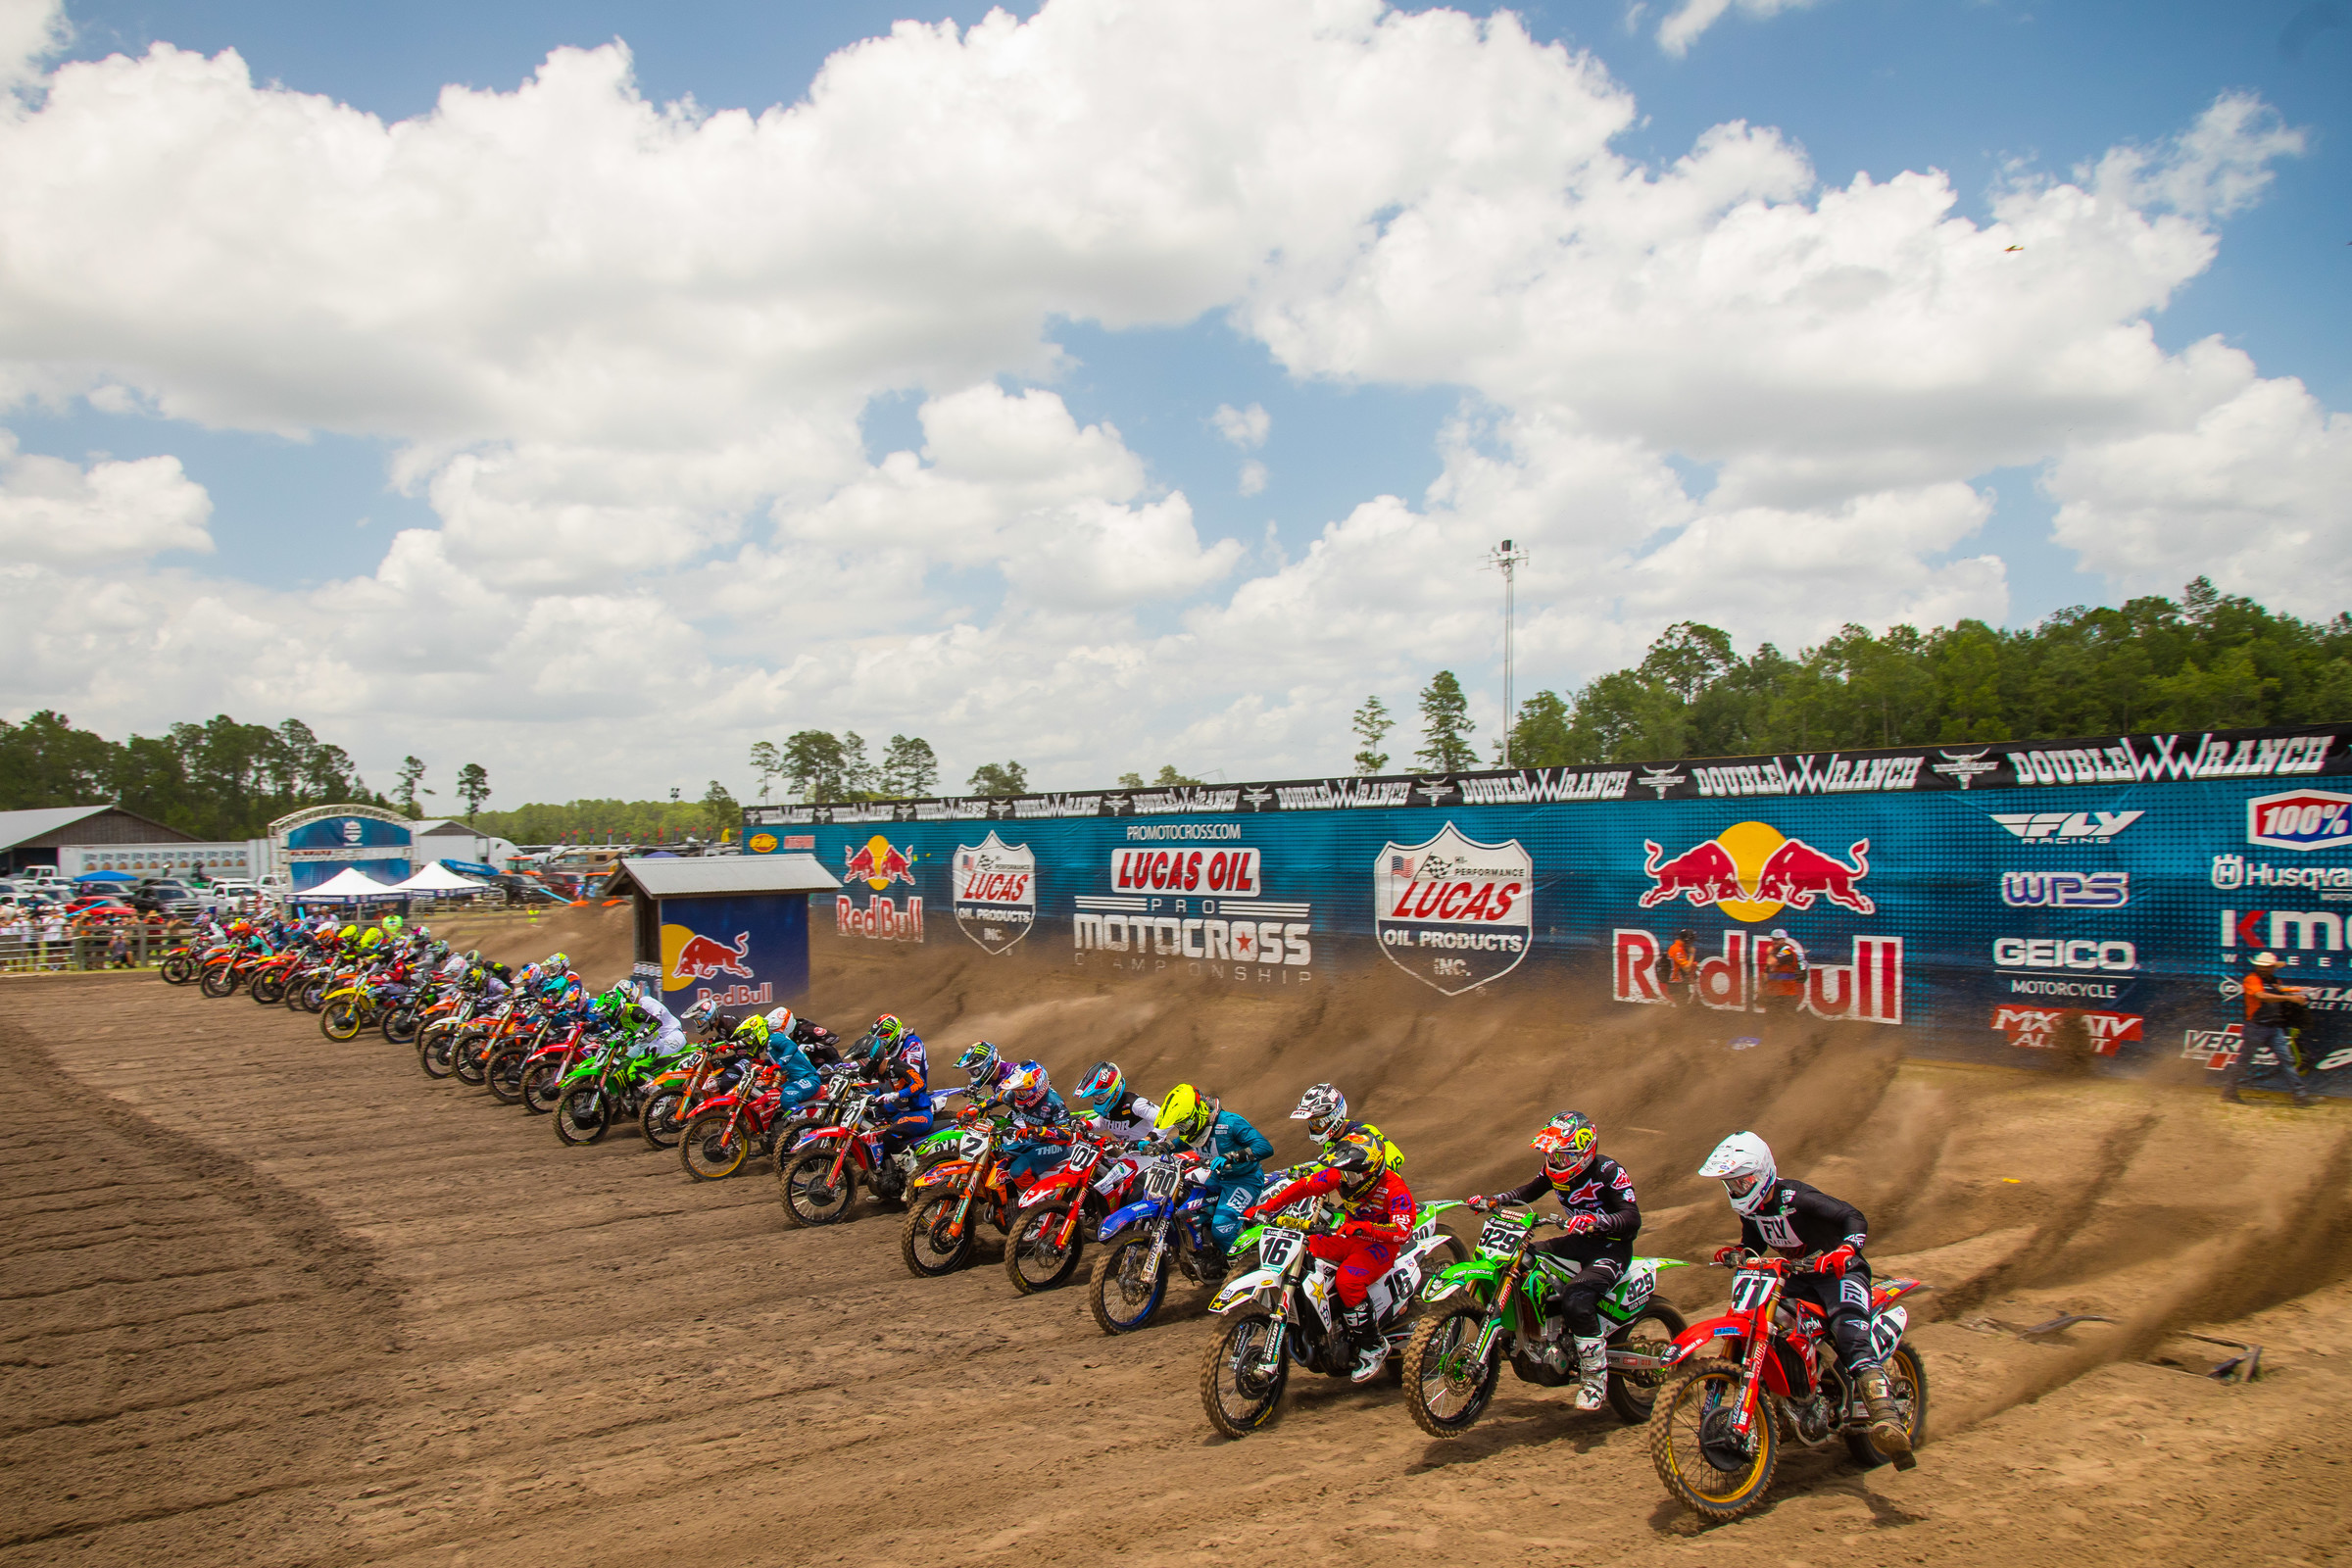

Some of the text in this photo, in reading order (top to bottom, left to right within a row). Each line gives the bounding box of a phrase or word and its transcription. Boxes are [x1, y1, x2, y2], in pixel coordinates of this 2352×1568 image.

[1990, 810, 2145, 837] FLY
[2263, 804, 2349, 835] 100%
[1117, 851, 1252, 891] LUCAS OIL
[1454, 868, 1525, 877] PERFORMANCE
[2245, 862, 2352, 891] Husqva
[963, 873, 1029, 902] LUCAS
[1392, 882, 1521, 920] LUCAS
[2001, 871, 2130, 908] WPS
[836, 894, 924, 943] Red Bull
[957, 907, 1031, 923] OIL PRODUCTS
[1151, 898, 1215, 914] PRO
[1073, 912, 1312, 965] MOTOCROSS
[1383, 929, 1523, 953] OIL PRODUCTS
[1434, 957, 1471, 977] INC.
[1993, 937, 2136, 971] GEICO
[1075, 953, 1312, 986] CAMPONSHIP
[1613, 928, 1747, 1012] Rd
[697, 982, 772, 1007] Red Bull
[2011, 979, 2117, 1000] MOTORCYCLE
[960, 1136, 984, 1157] 2
[1479, 1228, 1521, 1254] 929
[1761, 1218, 1788, 1240] FLY
[1262, 1237, 1293, 1266] 16
[1384, 1267, 1414, 1306] 16
[1627, 1272, 1654, 1302] 929
[1266, 1324, 1280, 1362] DUNLOP
[1872, 1314, 1903, 1356] 41
[1739, 1411, 1748, 1425] EBC
